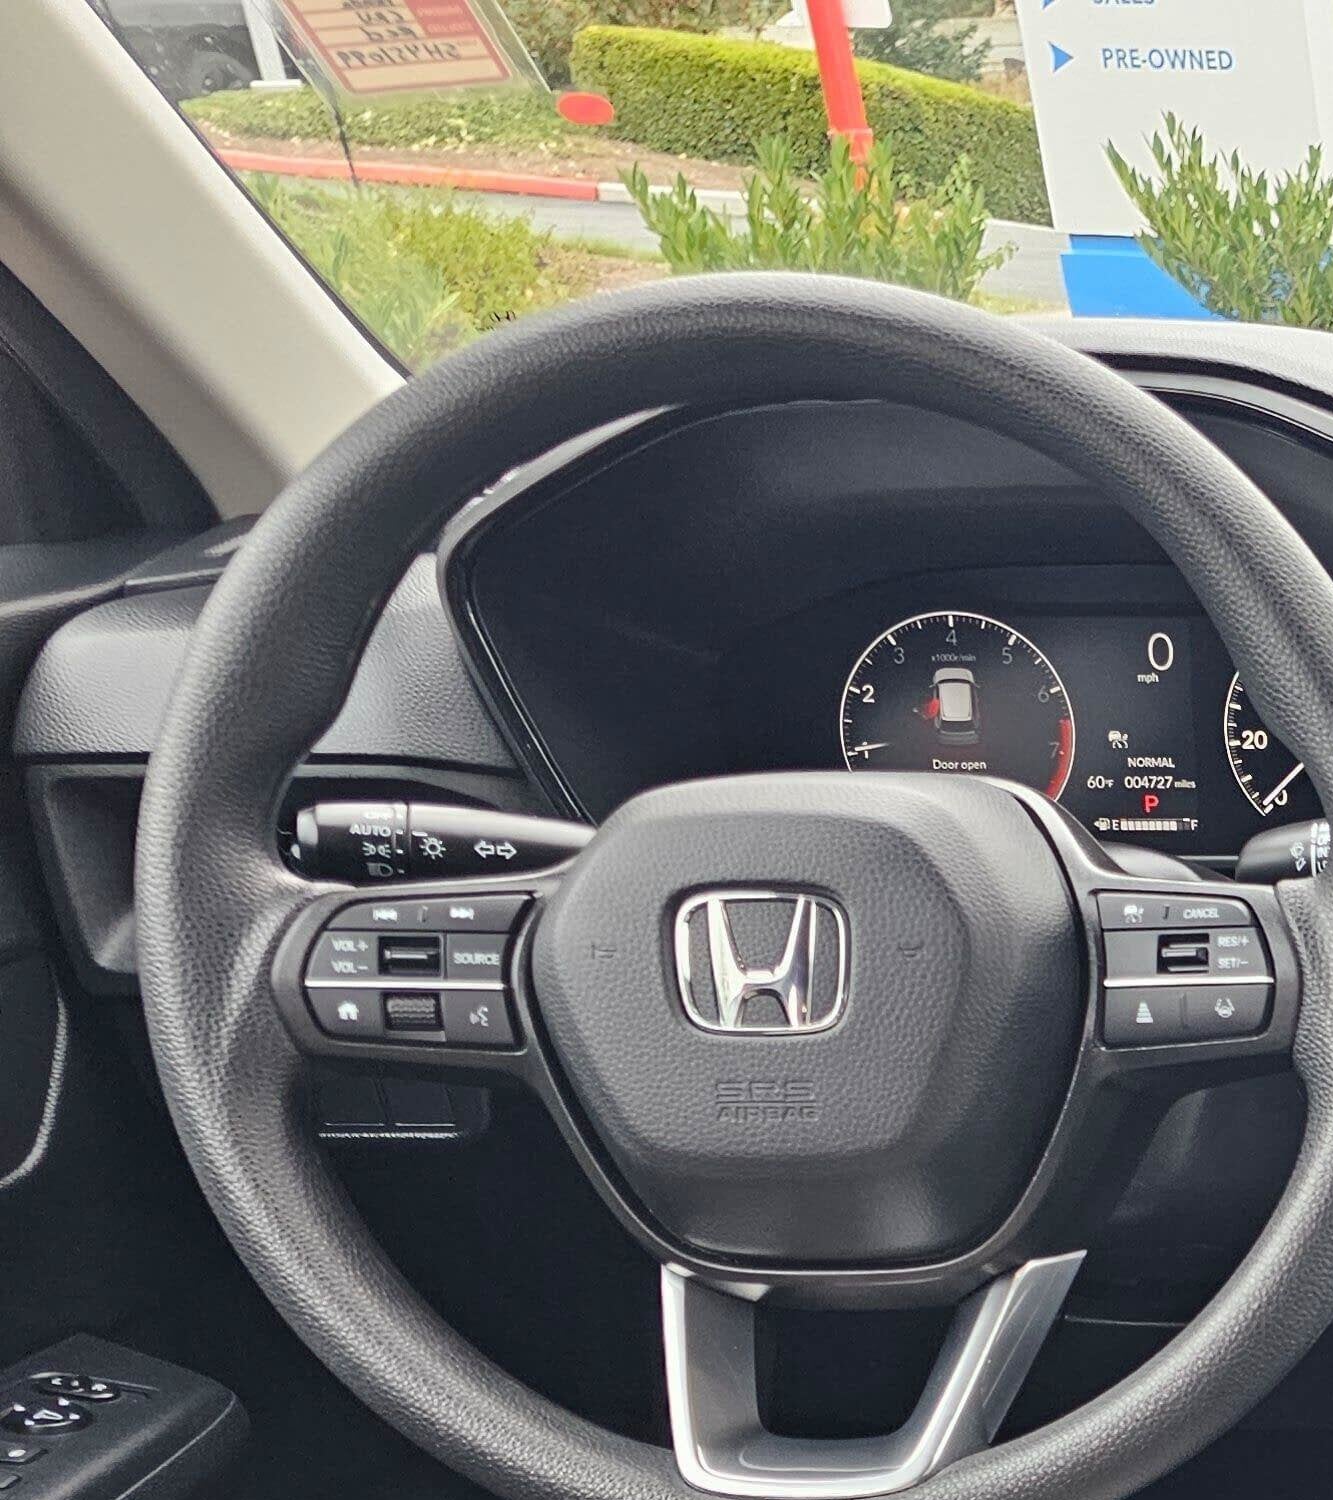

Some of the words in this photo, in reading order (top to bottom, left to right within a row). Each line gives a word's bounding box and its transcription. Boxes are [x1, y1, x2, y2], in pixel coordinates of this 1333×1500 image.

[1101, 48, 1233, 70] PRE-OWNED
[946, 630, 958, 646] 4
[894, 647, 905, 665] 3
[1002, 647, 1014, 665] 5
[1148, 632, 1174, 672] 0
[1137, 672, 1160, 684] mph
[861, 684, 876, 703] 2
[1037, 685, 1050, 703] 6
[1241, 730, 1268, 750] 20
[932, 759, 960, 771] Door
[961, 761, 987, 773] open
[1127, 756, 1176, 768] NORMAL
[1124, 775, 1173, 790] 004727
[1174, 778, 1197, 789] miles
[1144, 794, 1160, 814] P
[351, 823, 392, 838] AUTO
[1112, 818, 1121, 831] E
[1189, 818, 1199, 831] F
[1183, 907, 1220, 919] CANCEL
[453, 951, 500, 966] SOURCE
[715, 1080, 815, 1101] SRS
[715, 1105, 819, 1123] AIRBAG
